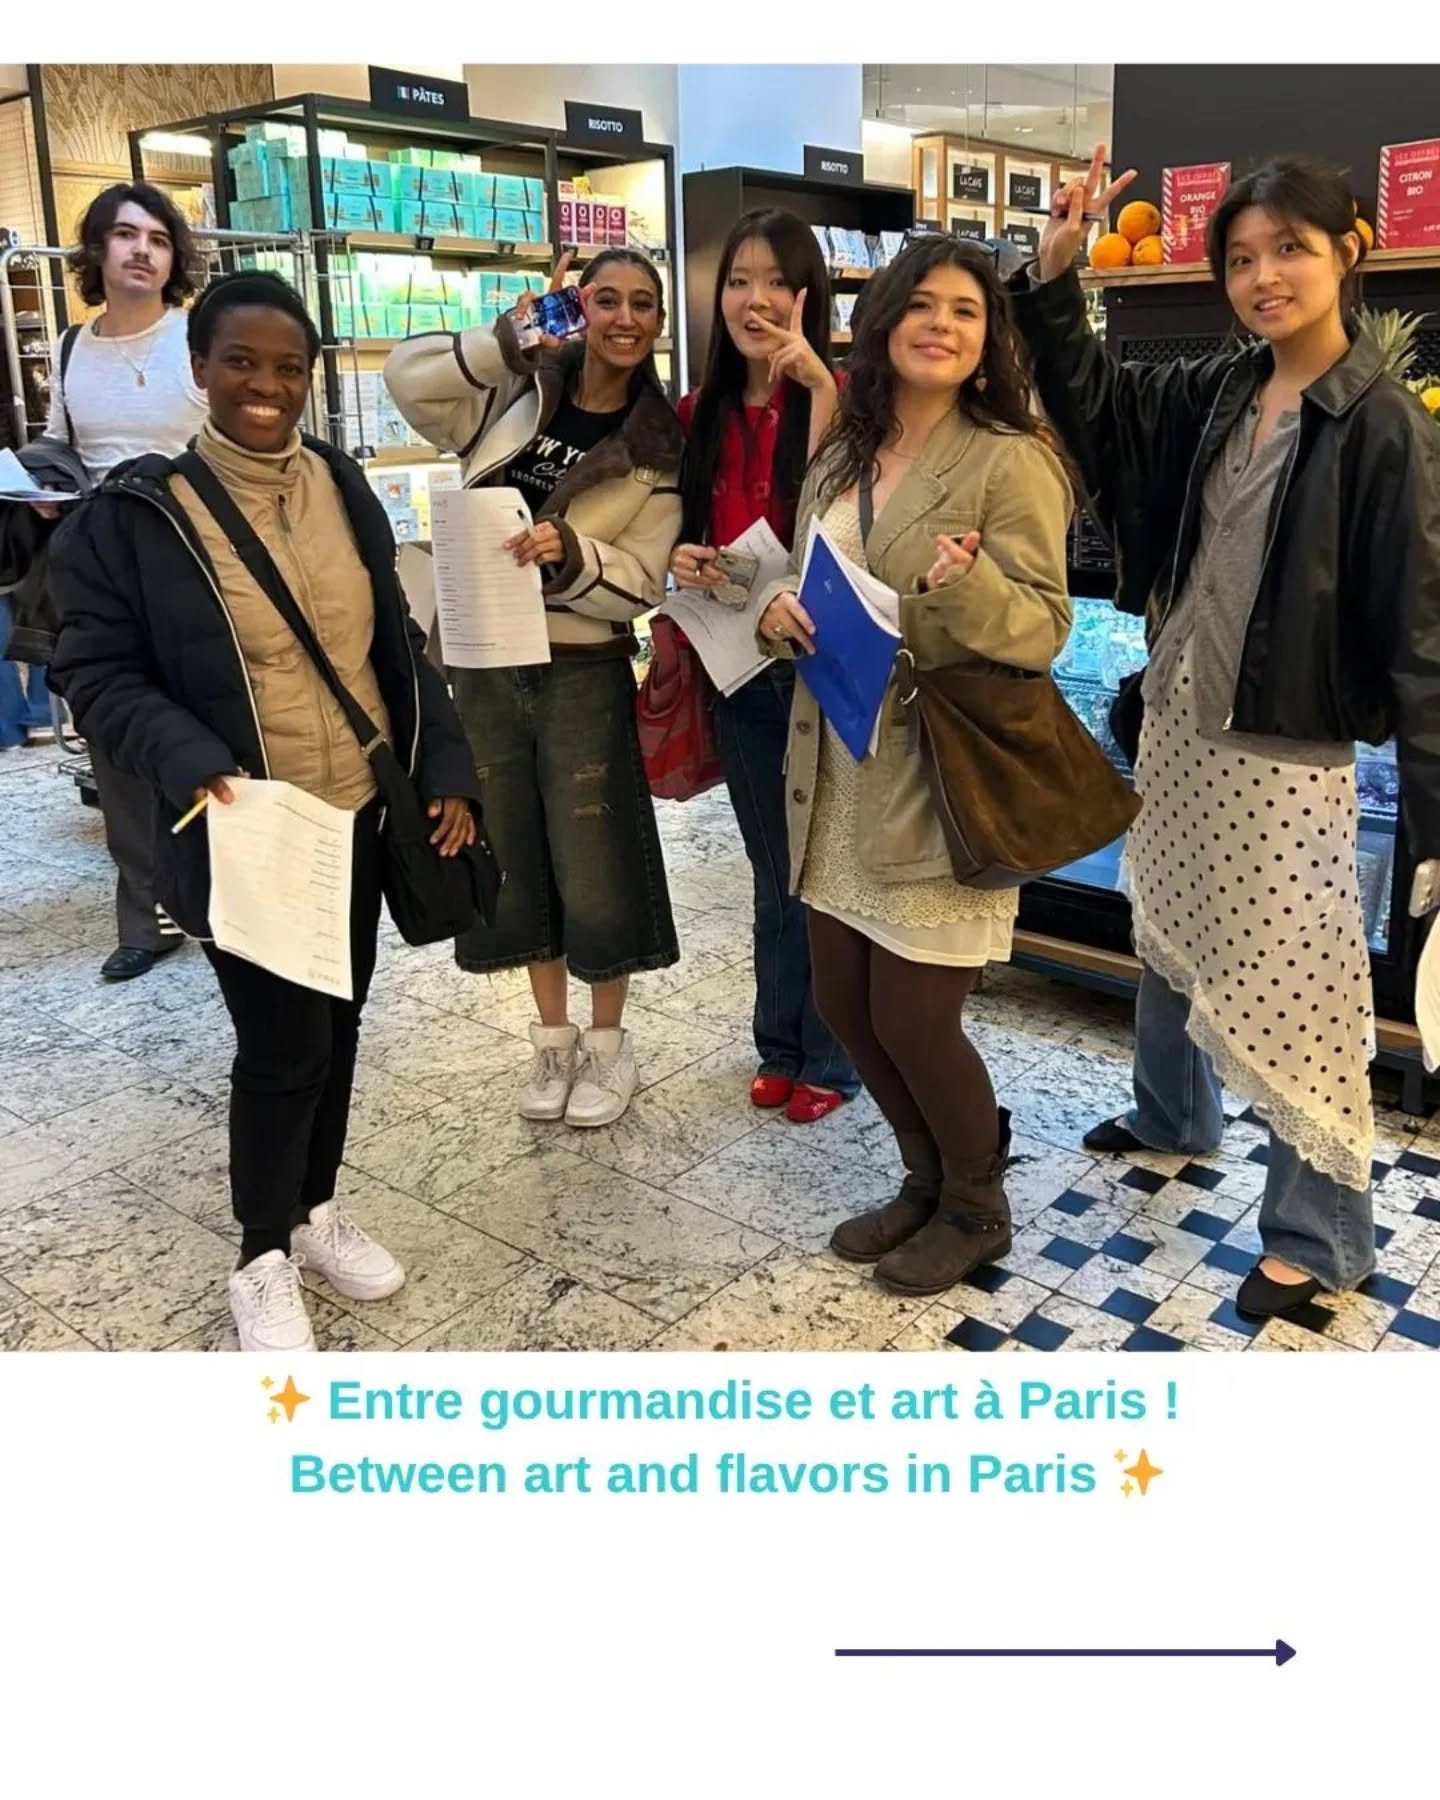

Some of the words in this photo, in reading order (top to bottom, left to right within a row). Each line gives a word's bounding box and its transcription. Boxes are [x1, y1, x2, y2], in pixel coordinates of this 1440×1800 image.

[412, 87, 445, 105] PÂTES
[588, 118, 623, 133] RISOTTO
[1399, 170, 1433, 184] CITRON
[1180, 191, 1216, 204] ORANGE
[1407, 185, 1424, 197] BIO
[511, 469, 560, 492] BROOKLY
